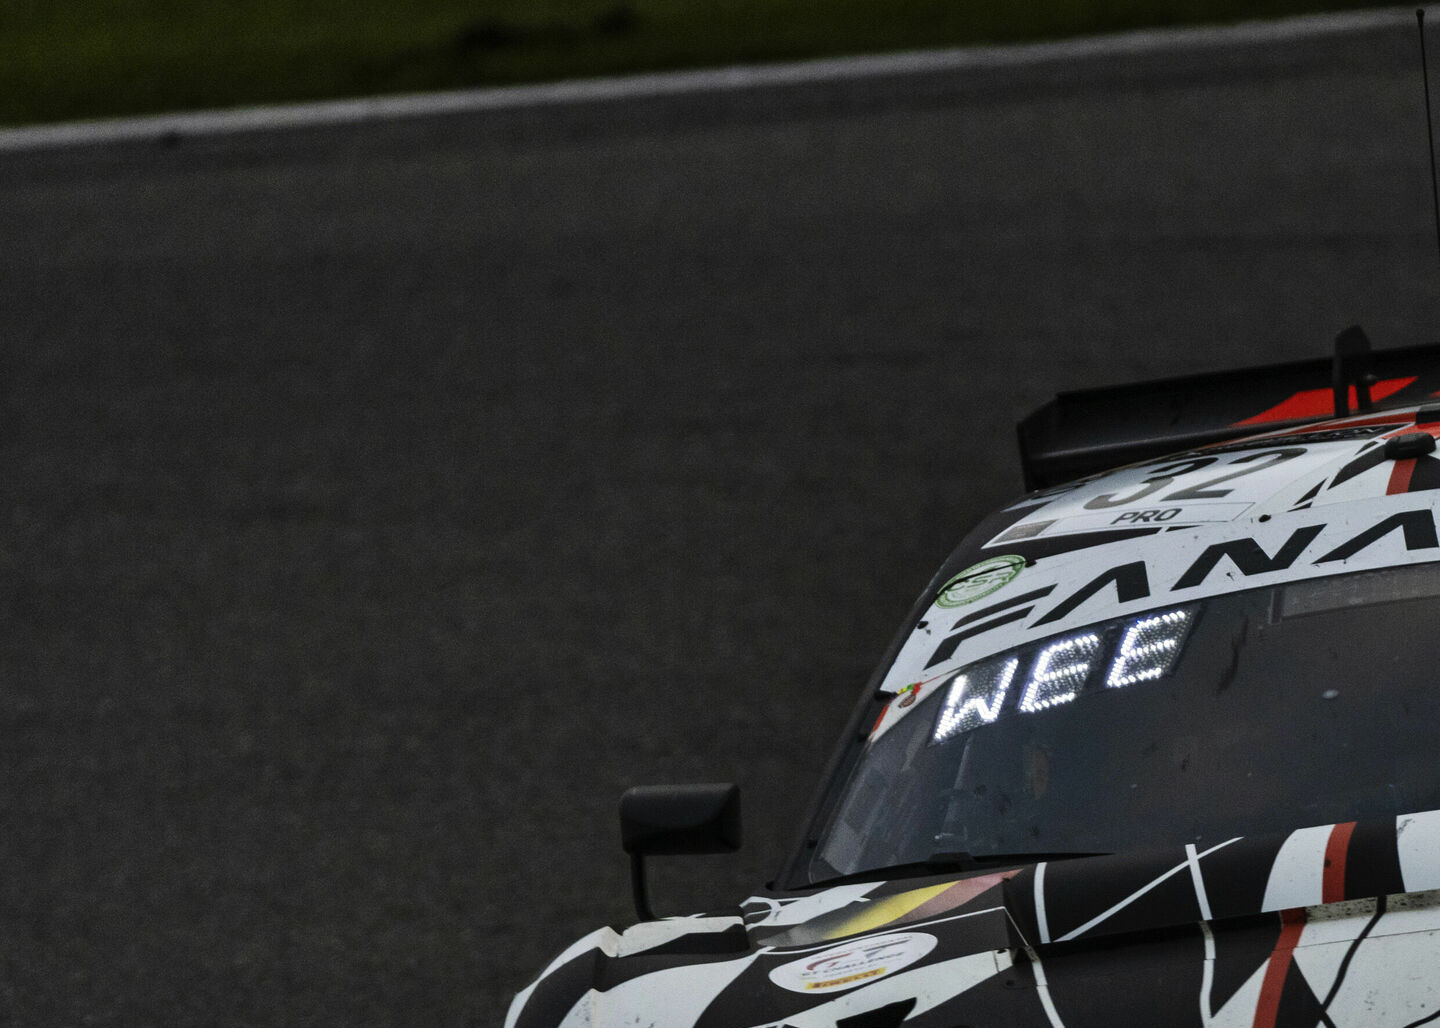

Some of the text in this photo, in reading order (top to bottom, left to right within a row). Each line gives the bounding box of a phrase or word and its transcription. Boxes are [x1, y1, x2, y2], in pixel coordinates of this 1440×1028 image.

[1083, 447, 1308, 510] 32
[1110, 508, 1182, 525] PRO
[932, 608, 1186, 743] WEE
